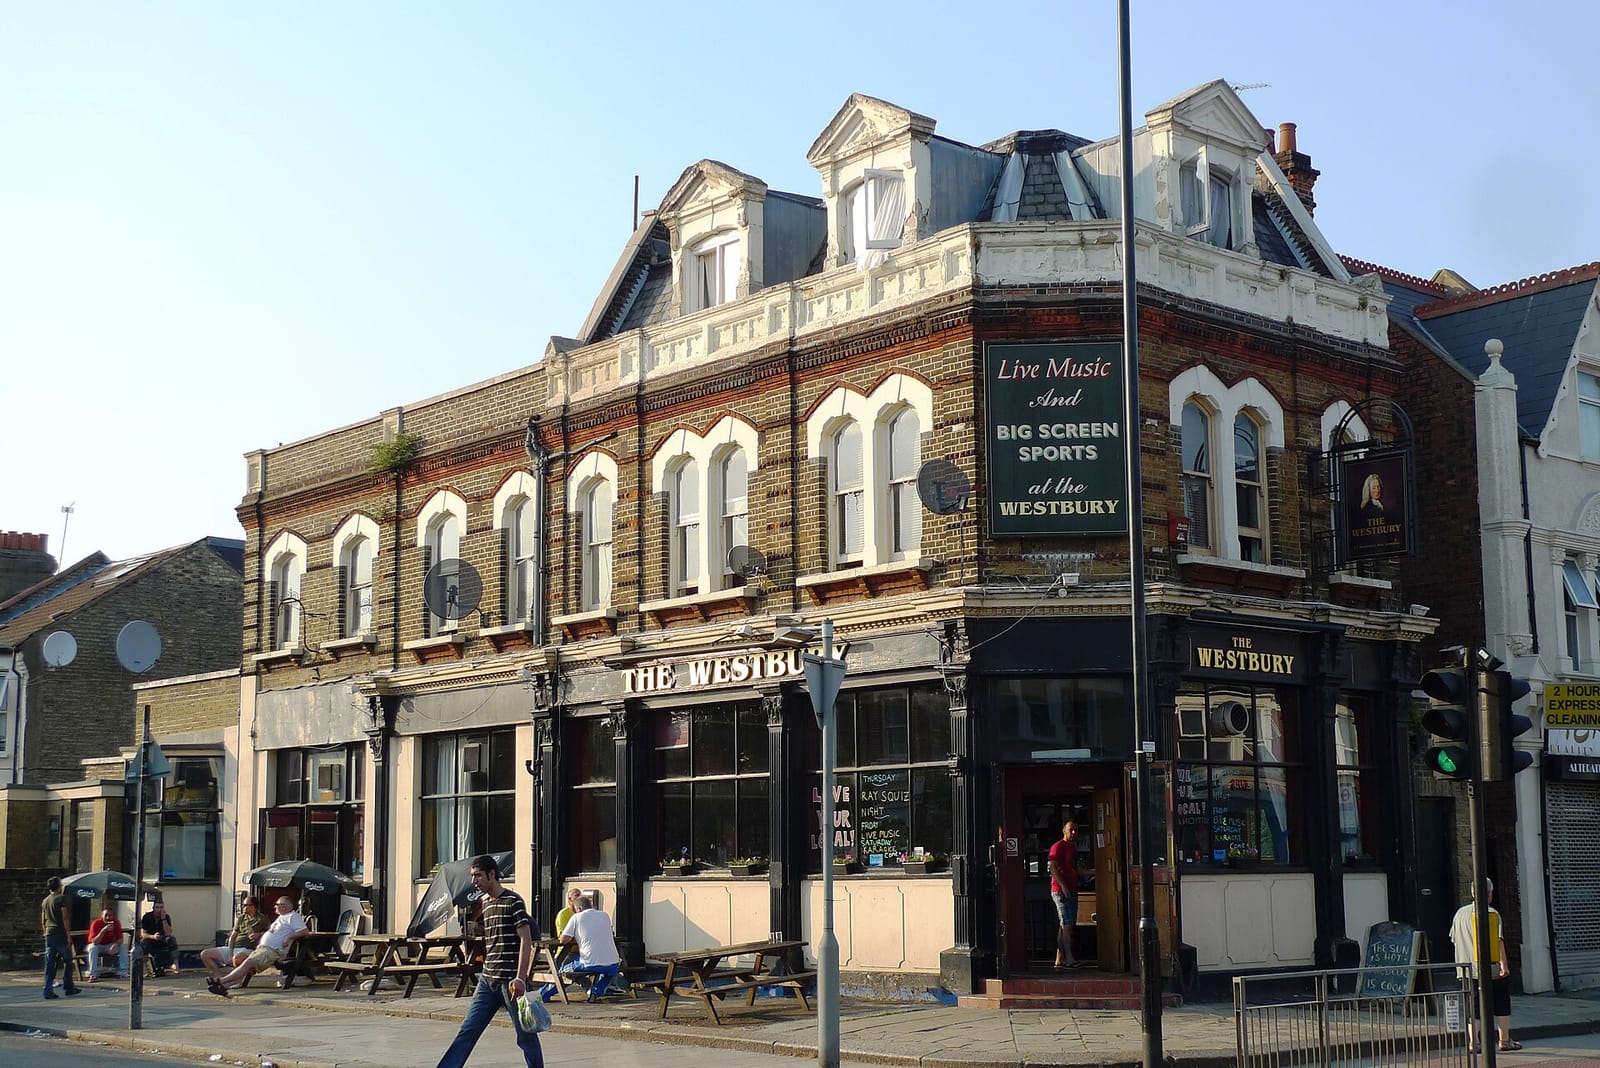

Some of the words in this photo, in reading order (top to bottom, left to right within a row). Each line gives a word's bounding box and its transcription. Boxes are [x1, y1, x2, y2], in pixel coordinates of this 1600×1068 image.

[998, 359, 1041, 380] Live
[1046, 357, 1112, 379] Music
[1029, 388, 1083, 408] And
[997, 425, 1033, 441] BIG
[1038, 423, 1120, 440] SCREEN
[1019, 445, 1099, 463] SPORTS
[1028, 479, 1053, 495] at
[1055, 477, 1089, 495] the
[999, 500, 1120, 516] WESTBURY
[1367, 517, 1386, 527] THE
[1352, 524, 1402, 537] WESTBURY
[1232, 637, 1252, 649] THE
[1197, 648, 1295, 674] WESTBURY
[621, 664, 676, 693] THE
[1553, 686, 1561, 697] 2
[1566, 685, 1600, 697] HOUR
[863, 774, 897, 783] THURSDAY
[812, 786, 850, 803] LVE
[816, 810, 851, 827] YUR
[861, 832, 878, 840] LIVE
[880, 829, 900, 839] MUSIC
[1371, 941, 1387, 955] THE
[1389, 943, 1409, 955] SUN
[1384, 953, 1401, 962] HOT
[1367, 979, 1376, 989] IS
